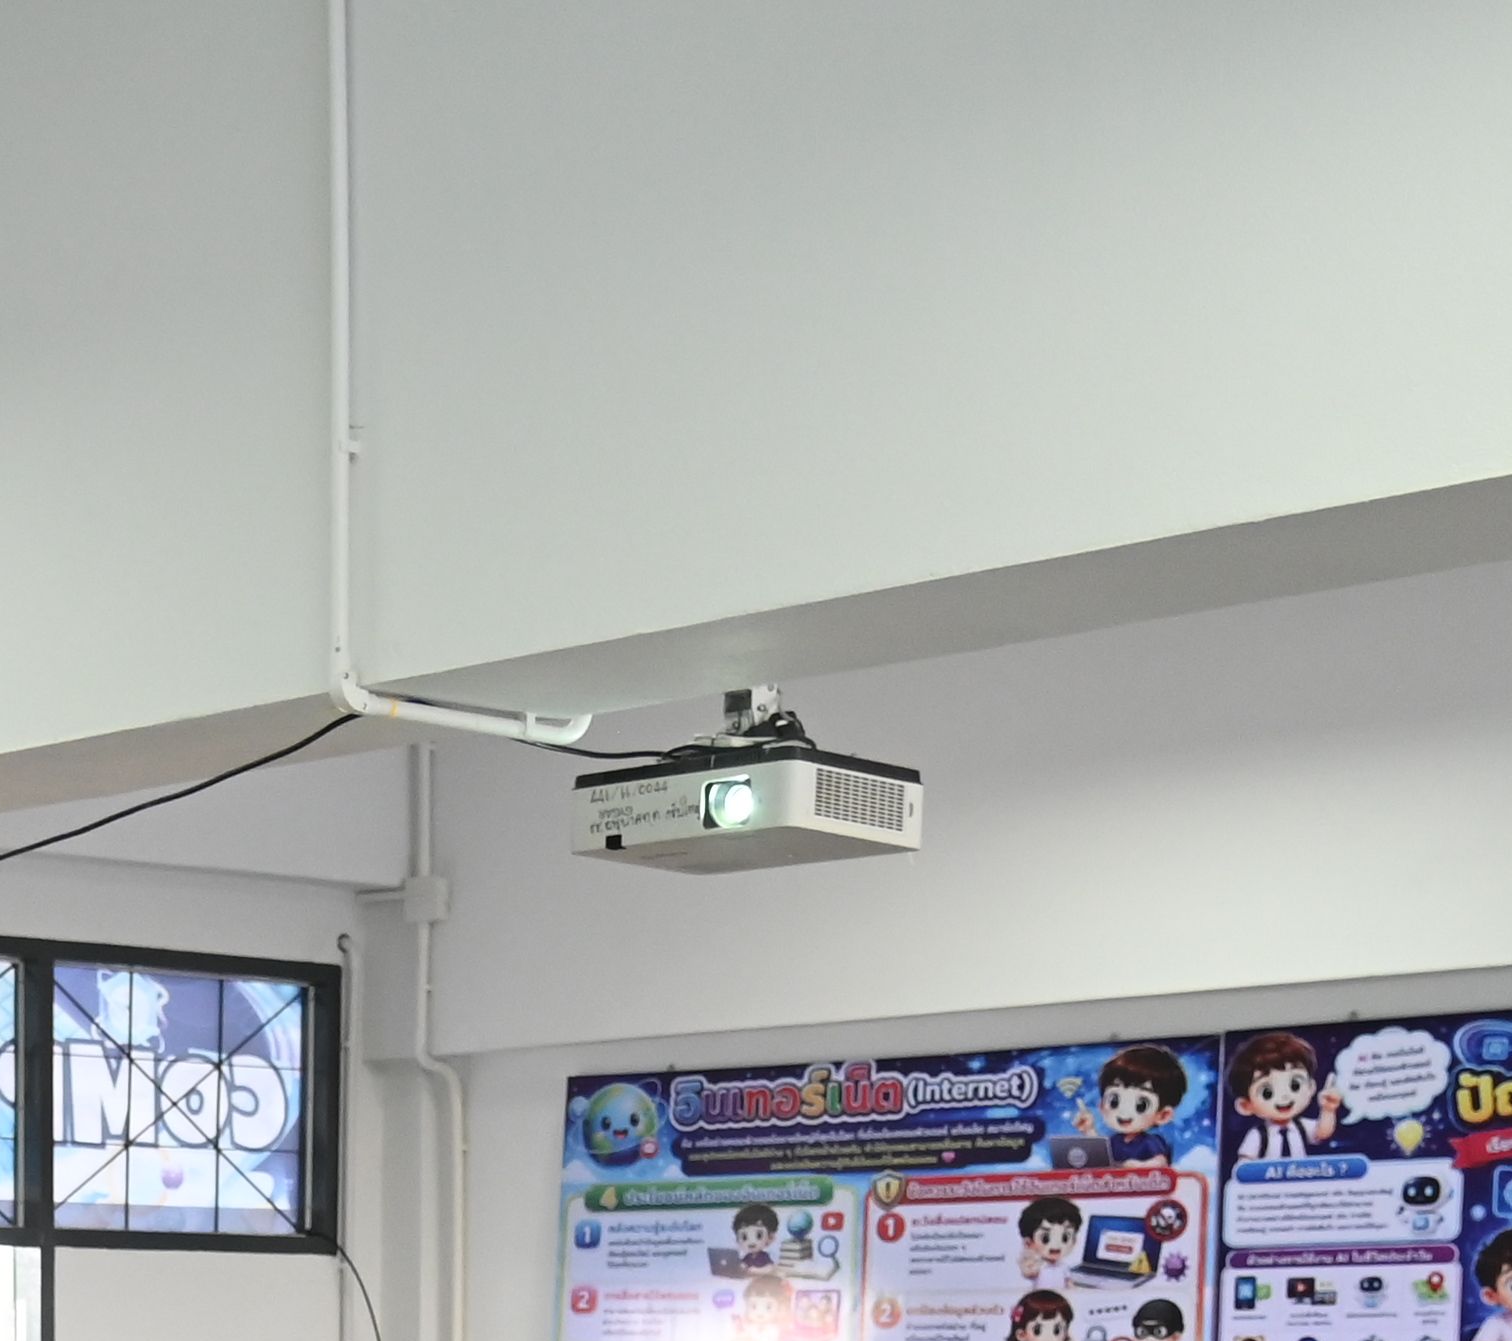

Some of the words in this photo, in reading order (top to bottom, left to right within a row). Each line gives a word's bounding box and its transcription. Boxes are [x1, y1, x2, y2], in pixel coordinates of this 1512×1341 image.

[674, 1066, 904, 1122] อินเทอร์เน็ต
[907, 1074, 1032, 1104] (Internet)
[1264, 1166, 1284, 1180] AI
[883, 1217, 897, 1238] 1
[878, 1303, 893, 1323] 2
